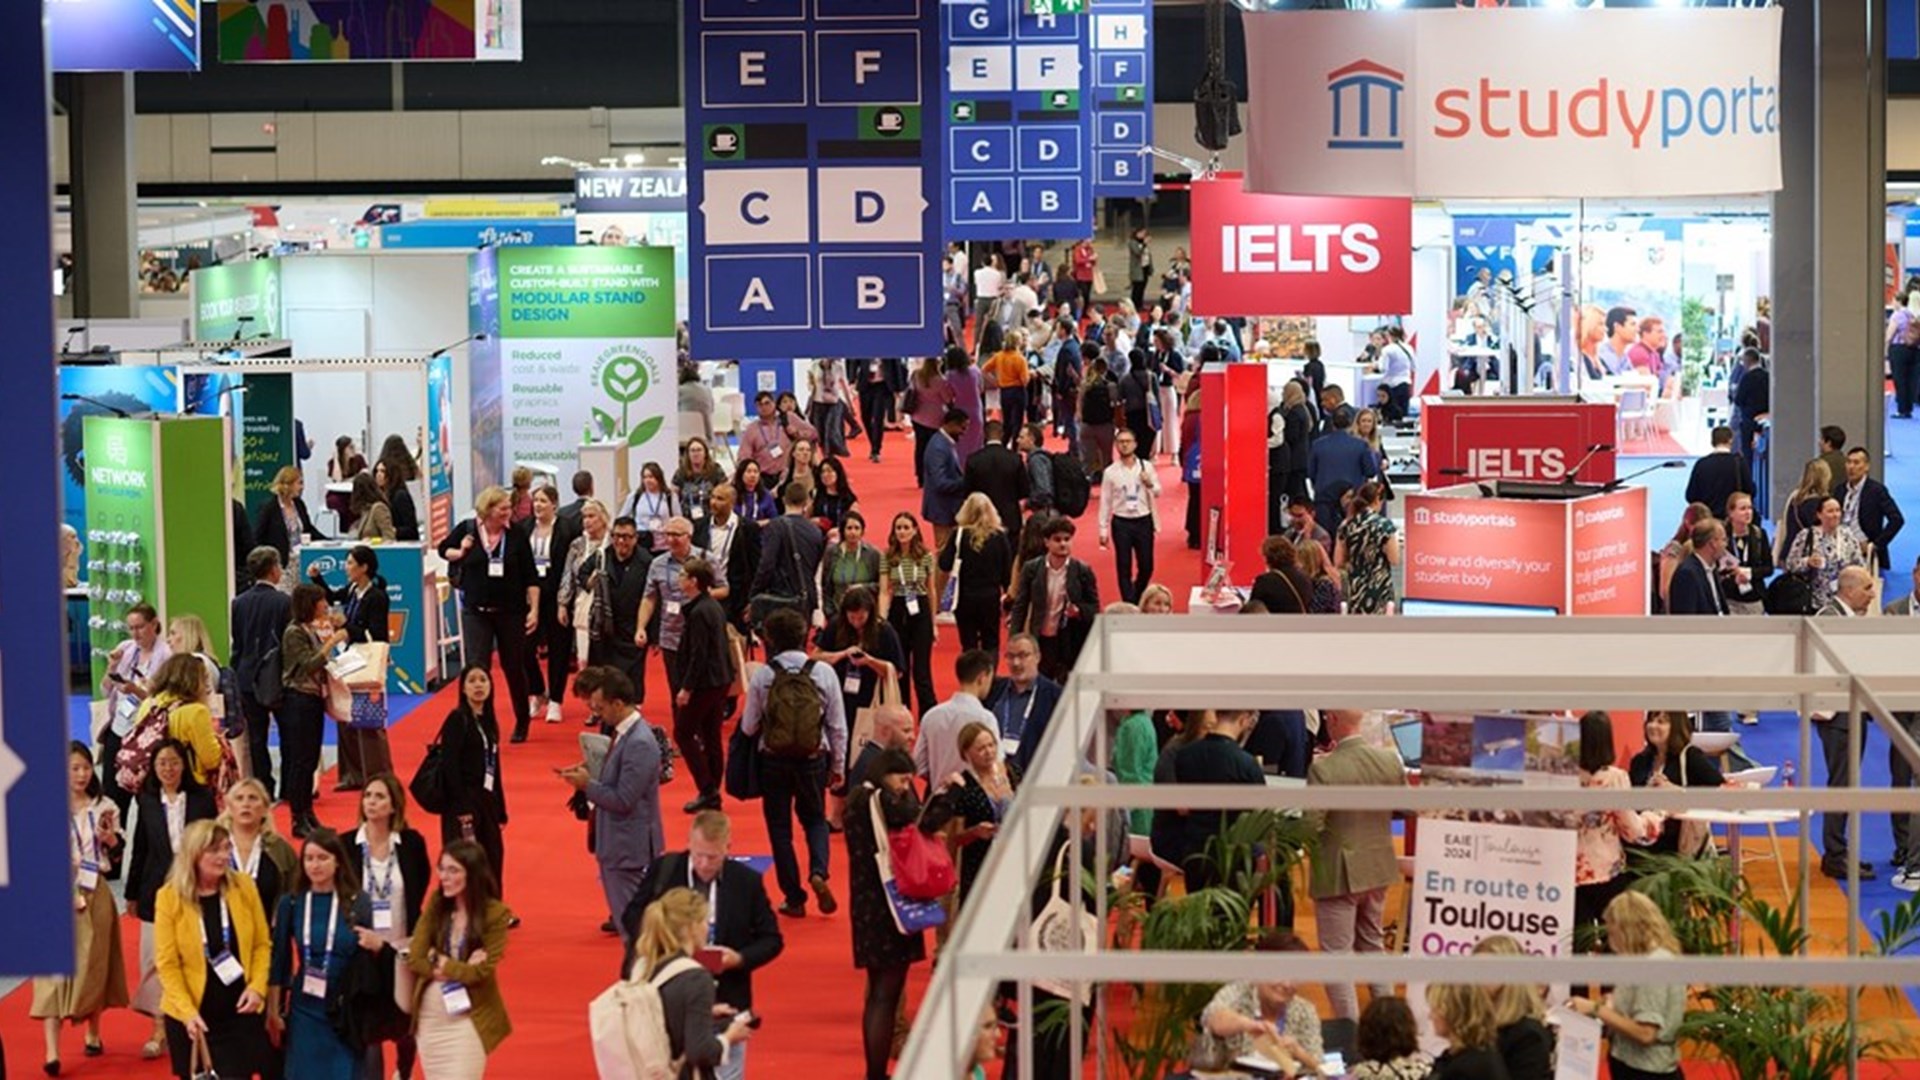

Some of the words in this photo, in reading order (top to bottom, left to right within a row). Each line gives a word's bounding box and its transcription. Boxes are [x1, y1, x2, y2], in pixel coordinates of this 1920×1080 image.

[969, 8, 989, 29] G
[1114, 26, 1127, 40] H
[740, 51, 766, 85] E
[855, 51, 881, 84] F
[972, 58, 988, 78] E
[1040, 58, 1055, 77] F
[1114, 61, 1128, 78] F
[1114, 122, 1129, 139] D
[971, 140, 991, 161] C
[1038, 140, 1059, 160] D
[1114, 160, 1129, 176] B
[579, 178, 623, 198] NEW
[740, 191, 770, 225] C
[855, 191, 885, 224] D
[971, 191, 993, 212] A
[1040, 190, 1059, 211] B
[1222, 223, 1381, 273] IELTS
[510, 265, 553, 275] CREATE
[558, 266, 566, 274] A
[568, 264, 644, 275] SUSTAINABLE
[510, 278, 589, 289] CUSTOM-BUILT
[592, 278, 628, 288] STAND
[630, 277, 660, 288] WITH
[857, 276, 886, 310] B
[511, 292, 590, 305] MODULAR
[594, 291, 646, 304] STAND
[739, 277, 774, 312] A
[511, 308, 569, 321] DESIGN
[512, 350, 562, 361] Reduced
[512, 383, 563, 394] Reusable
[513, 417, 560, 428] Efficient
[514, 450, 578, 461] Sustainable
[1468, 447, 1566, 479] IELTS
[91, 467, 147, 489] NETWORK
[1433, 511, 1517, 528] studyportals
[1415, 552, 1448, 566] Grow
[1449, 553, 1472, 568] and
[1473, 554, 1522, 575] diversify
[1524, 561, 1551, 574] your
[1414, 571, 1460, 584] student
[1462, 573, 1493, 588] body
[1444, 833, 1472, 847] EAIE
[1444, 847, 1472, 859] 2024
[1426, 870, 1456, 893] En
[1464, 878, 1529, 900] route
[1536, 881, 1562, 903] to
[1424, 897, 1560, 936] Toulouse
